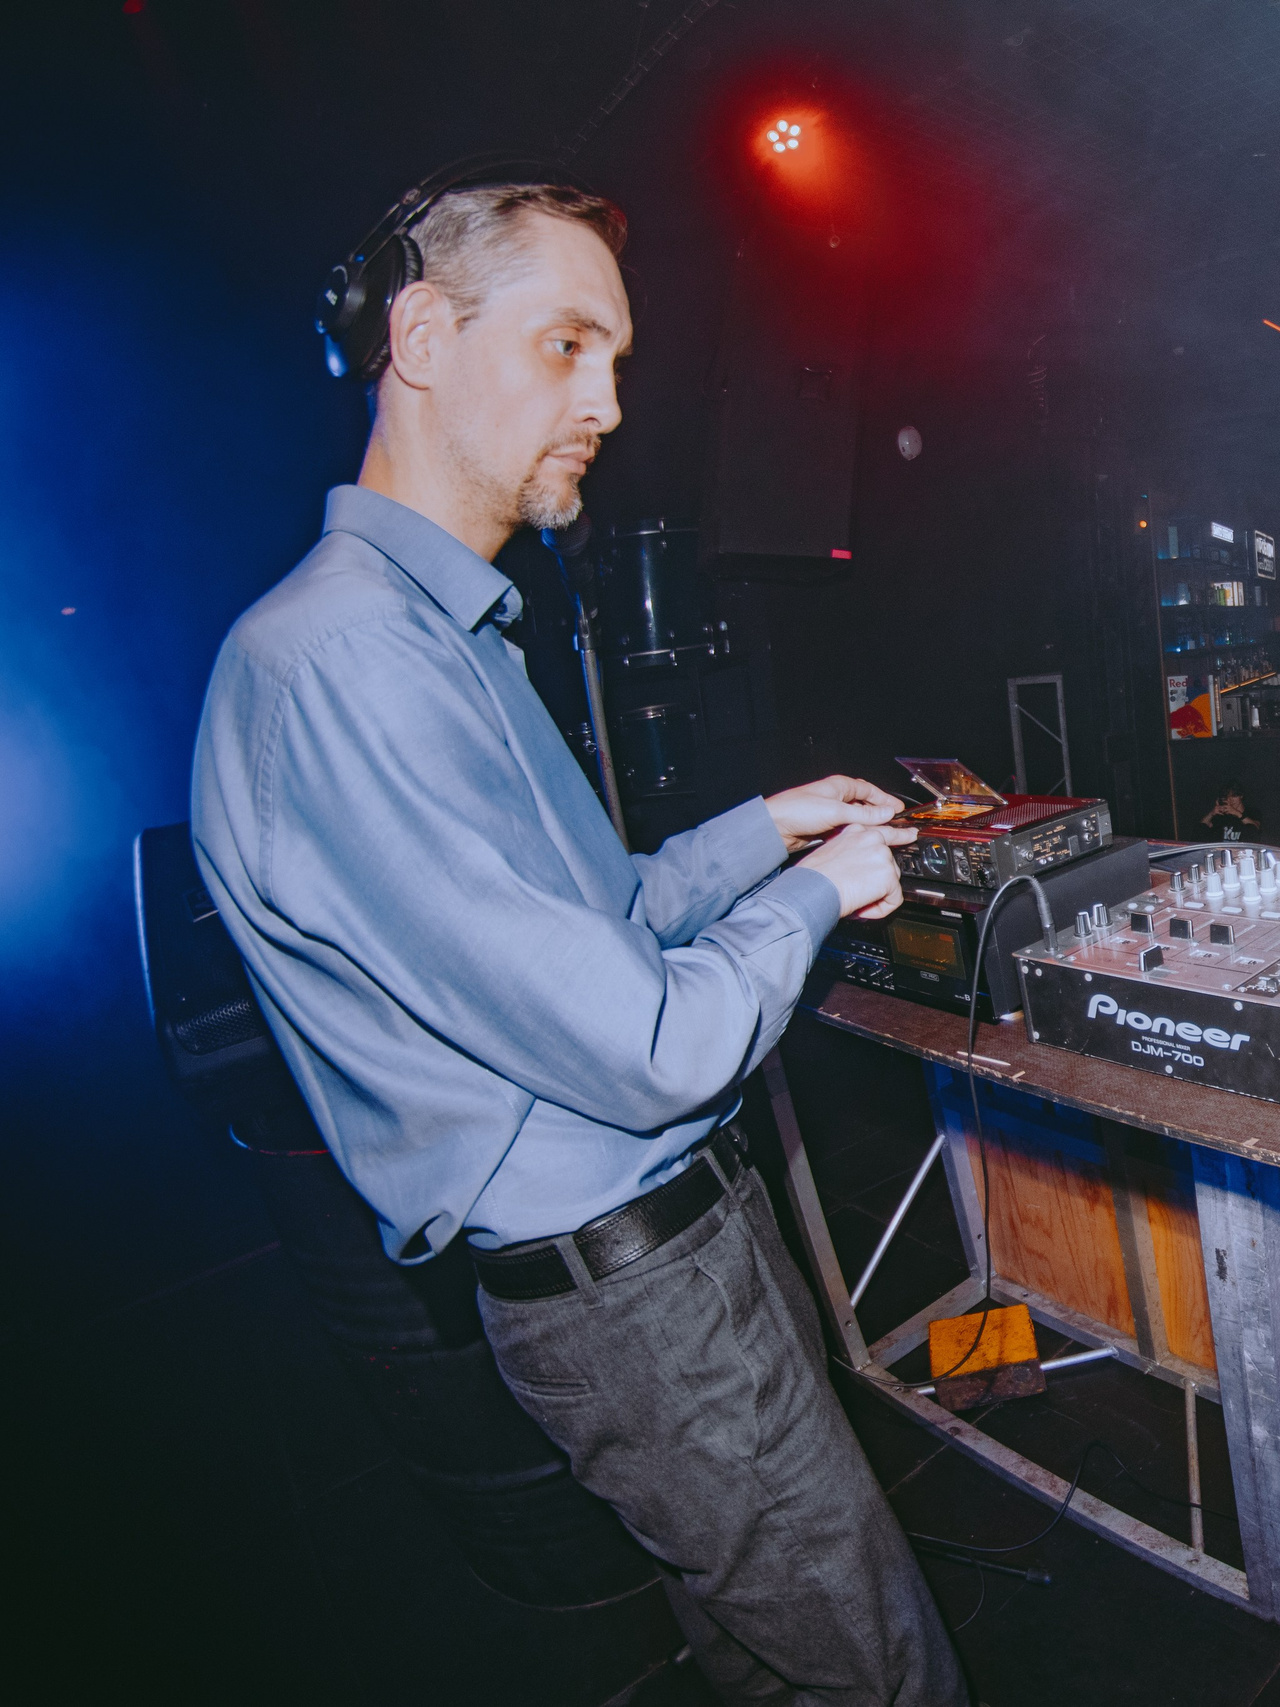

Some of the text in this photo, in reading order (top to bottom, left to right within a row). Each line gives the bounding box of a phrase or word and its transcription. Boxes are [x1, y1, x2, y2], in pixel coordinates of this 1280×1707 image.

[1169, 678, 1188, 688] Red
[1087, 994, 1251, 1051] Pioneer
[1130, 1040, 1205, 1067] DJM-700
[1141, 1035, 1191, 1052] PROFESSIONAL MIXER
